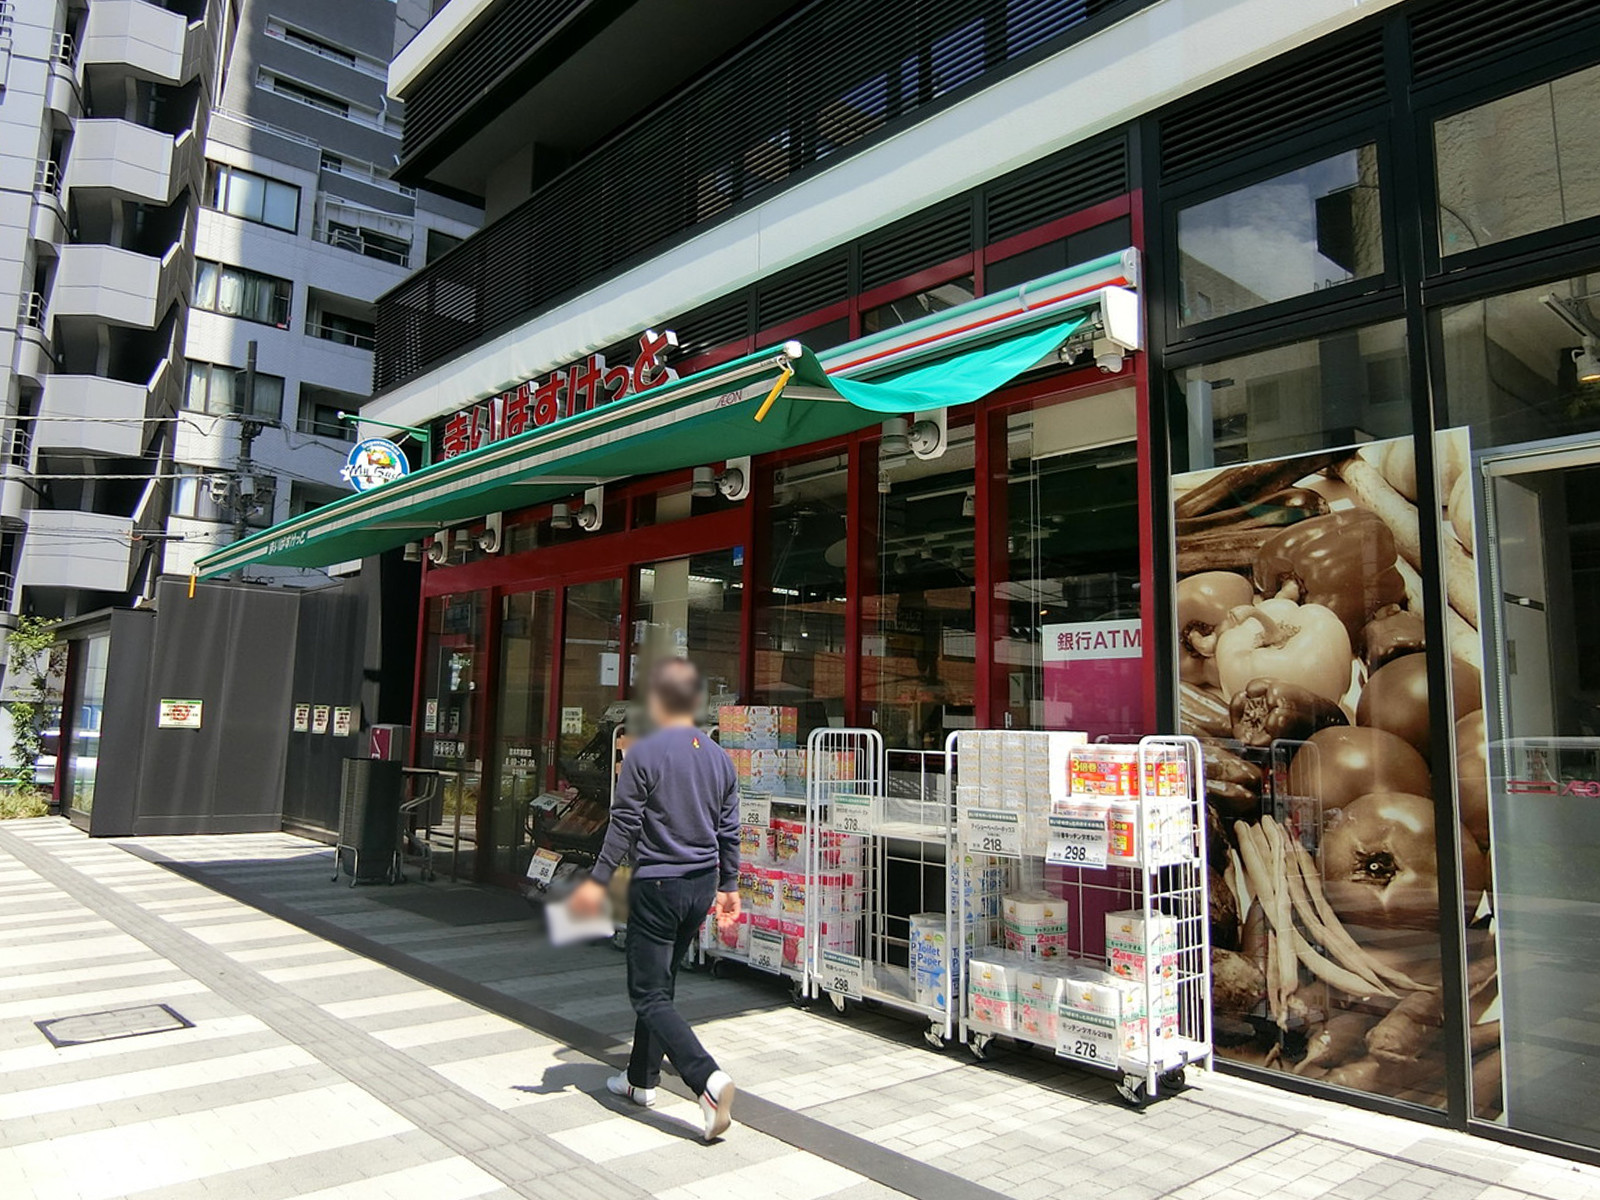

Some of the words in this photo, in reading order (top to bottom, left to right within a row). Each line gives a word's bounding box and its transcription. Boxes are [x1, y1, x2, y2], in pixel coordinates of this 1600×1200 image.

[444, 331, 675, 460] まいばすけっと
[1057, 628, 1141, 651] 銀行ATM
[983, 837, 1002, 851] 218
[1065, 845, 1086, 861] 298
[918, 941, 940, 956] Toilet
[917, 952, 942, 967] Paper
[834, 976, 849, 992] 298
[1074, 1040, 1097, 1058] 278
